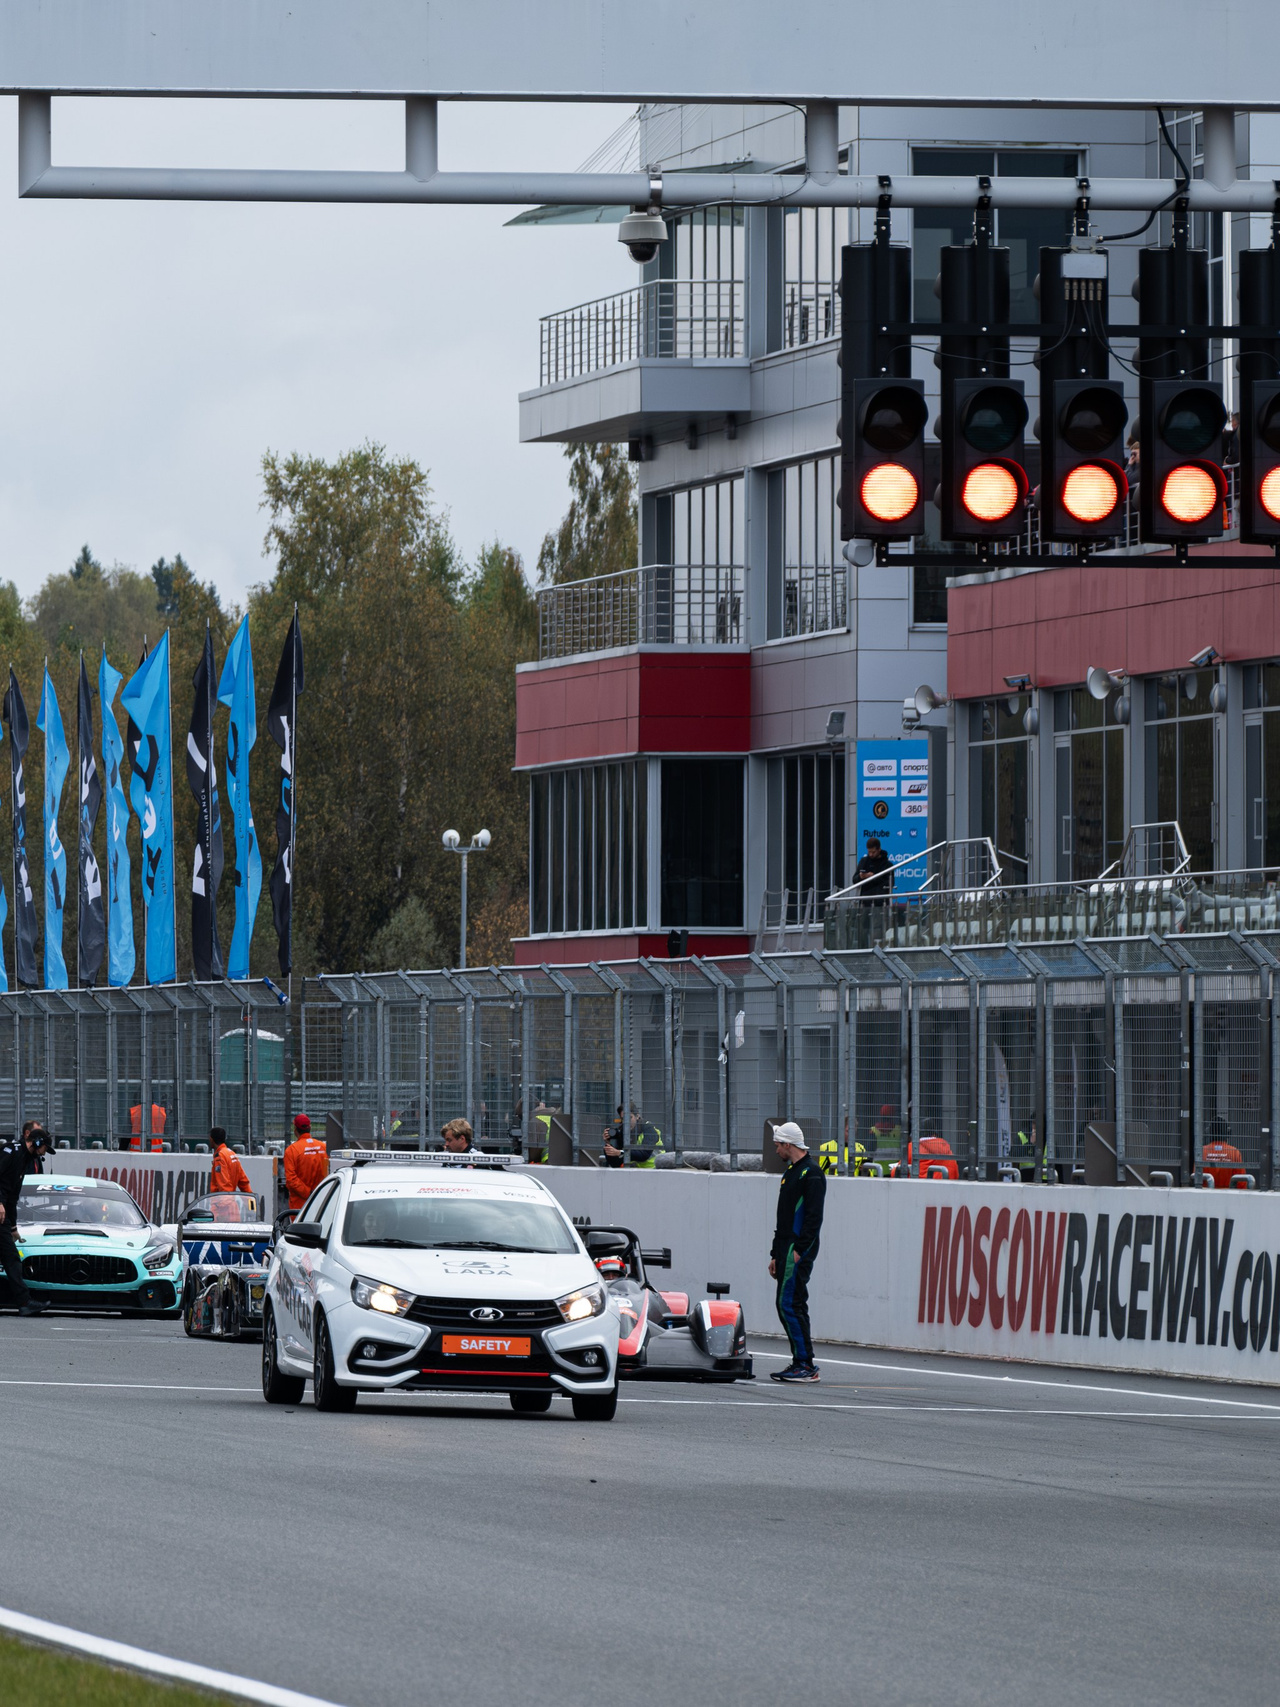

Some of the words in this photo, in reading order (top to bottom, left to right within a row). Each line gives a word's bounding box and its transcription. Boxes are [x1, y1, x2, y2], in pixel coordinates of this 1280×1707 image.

[907, 805, 923, 813] 360
[863, 829, 890, 838] Rutube
[502, 1191, 537, 1199] VESTA
[443, 1267, 514, 1277] LADA
[460, 1338, 512, 1351] SAFETY
